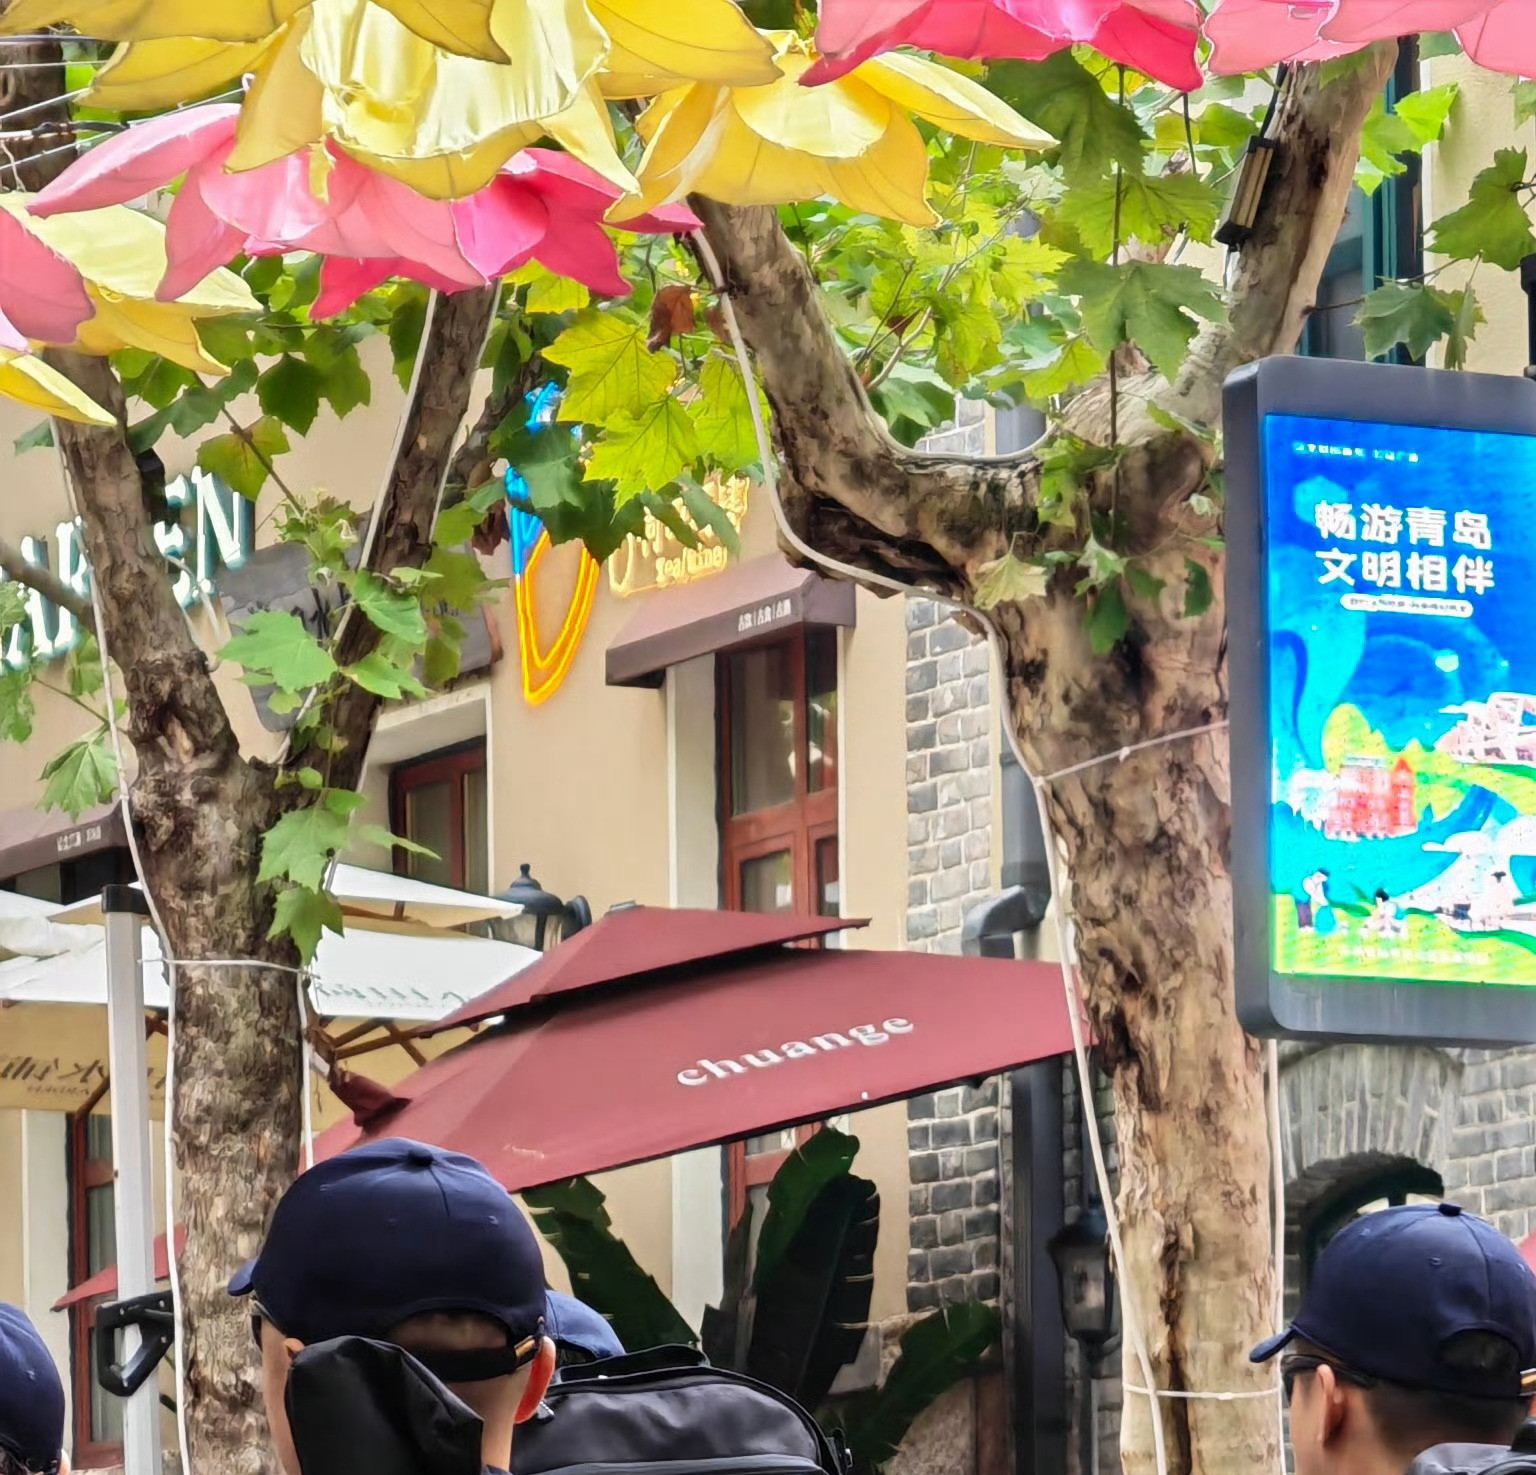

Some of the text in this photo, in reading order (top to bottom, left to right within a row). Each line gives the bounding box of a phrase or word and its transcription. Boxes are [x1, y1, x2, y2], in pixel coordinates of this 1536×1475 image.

[1314, 499, 1493, 550] 畅游青岛
[1314, 547, 1496, 595] 文明相伴
[676, 1017, 914, 1086] chuange
